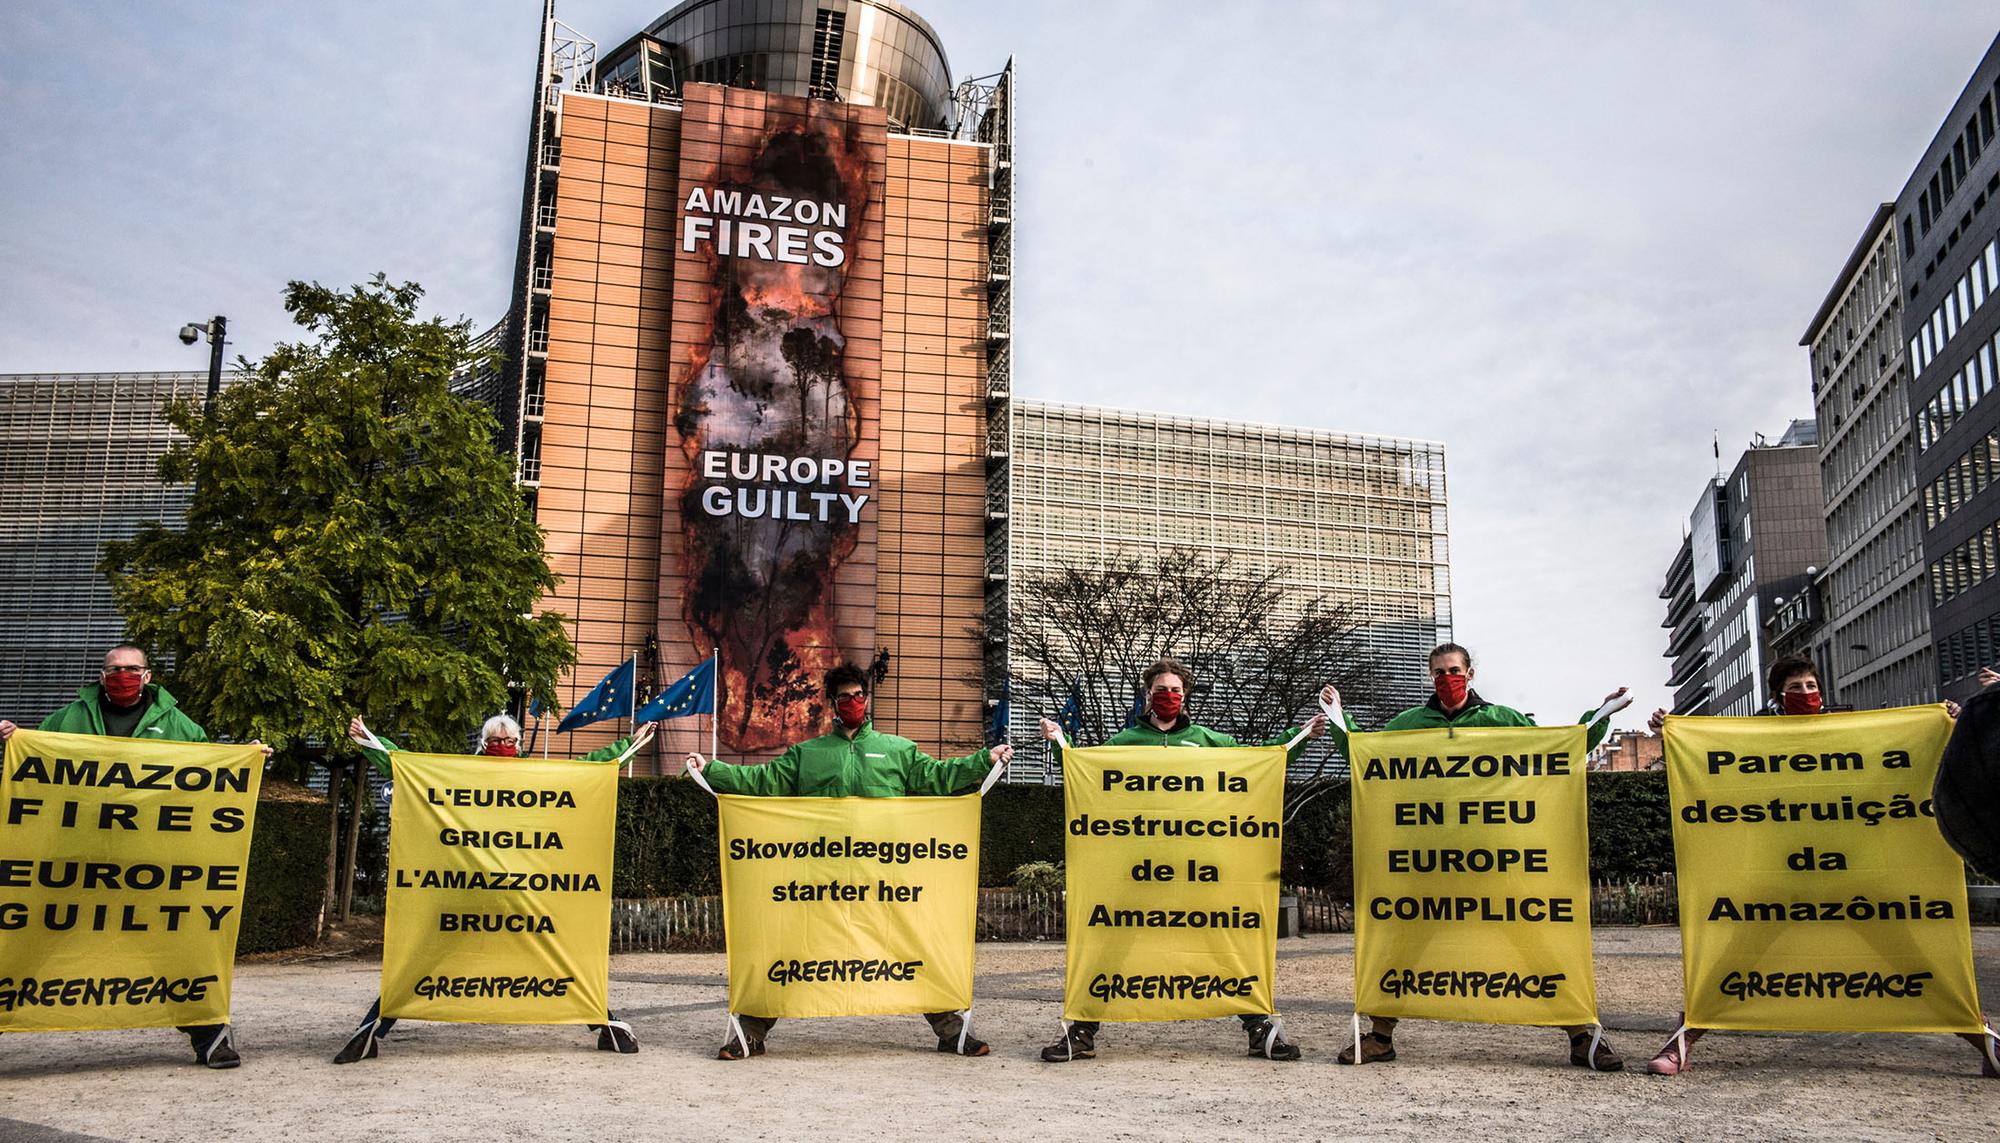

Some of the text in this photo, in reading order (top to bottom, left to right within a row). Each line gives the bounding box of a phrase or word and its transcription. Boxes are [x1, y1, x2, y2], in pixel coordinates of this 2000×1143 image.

[684, 187, 846, 228] AMAZON
[683, 216, 846, 268] FIRES
[703, 450, 871, 488] EUROPE
[702, 485, 869, 524] GUILTY
[10, 756, 251, 793] AMAZON
[1362, 751, 1571, 781] AMAZONIE
[1707, 750, 1913, 775] Parem a
[1102, 769, 1248, 793] Paren la
[427, 787, 576, 809] L'EUROPA
[7, 797, 245, 833] FIRES
[1069, 813, 1280, 839] destrucción
[1395, 799, 1536, 826] EN FEU
[439, 828, 564, 850] GRIGLIA
[729, 836, 968, 864] Skovødelæggelse
[1131, 859, 1219, 882] de la
[1388, 848, 1548, 873] EUROPE
[1786, 846, 1848, 872] da
[0, 859, 240, 892] EUROPE
[396, 869, 602, 892] L'AMAZZONIA
[772, 880, 923, 902] starter her
[0, 902, 235, 932] GUILTY
[1087, 904, 1261, 929] Amazonia
[1369, 896, 1574, 923] COMPLICE
[1707, 894, 1955, 922] Amazônia
[439, 912, 556, 934] BRUCIA
[767, 959, 924, 986] GREENPEACE
[1379, 968, 1566, 999] GREENPEACE
[1718, 970, 1935, 1001] GREENPEACE
[414, 975, 575, 1001] GREENPEACE
[1088, 974, 1259, 1001] GREENPEACE
